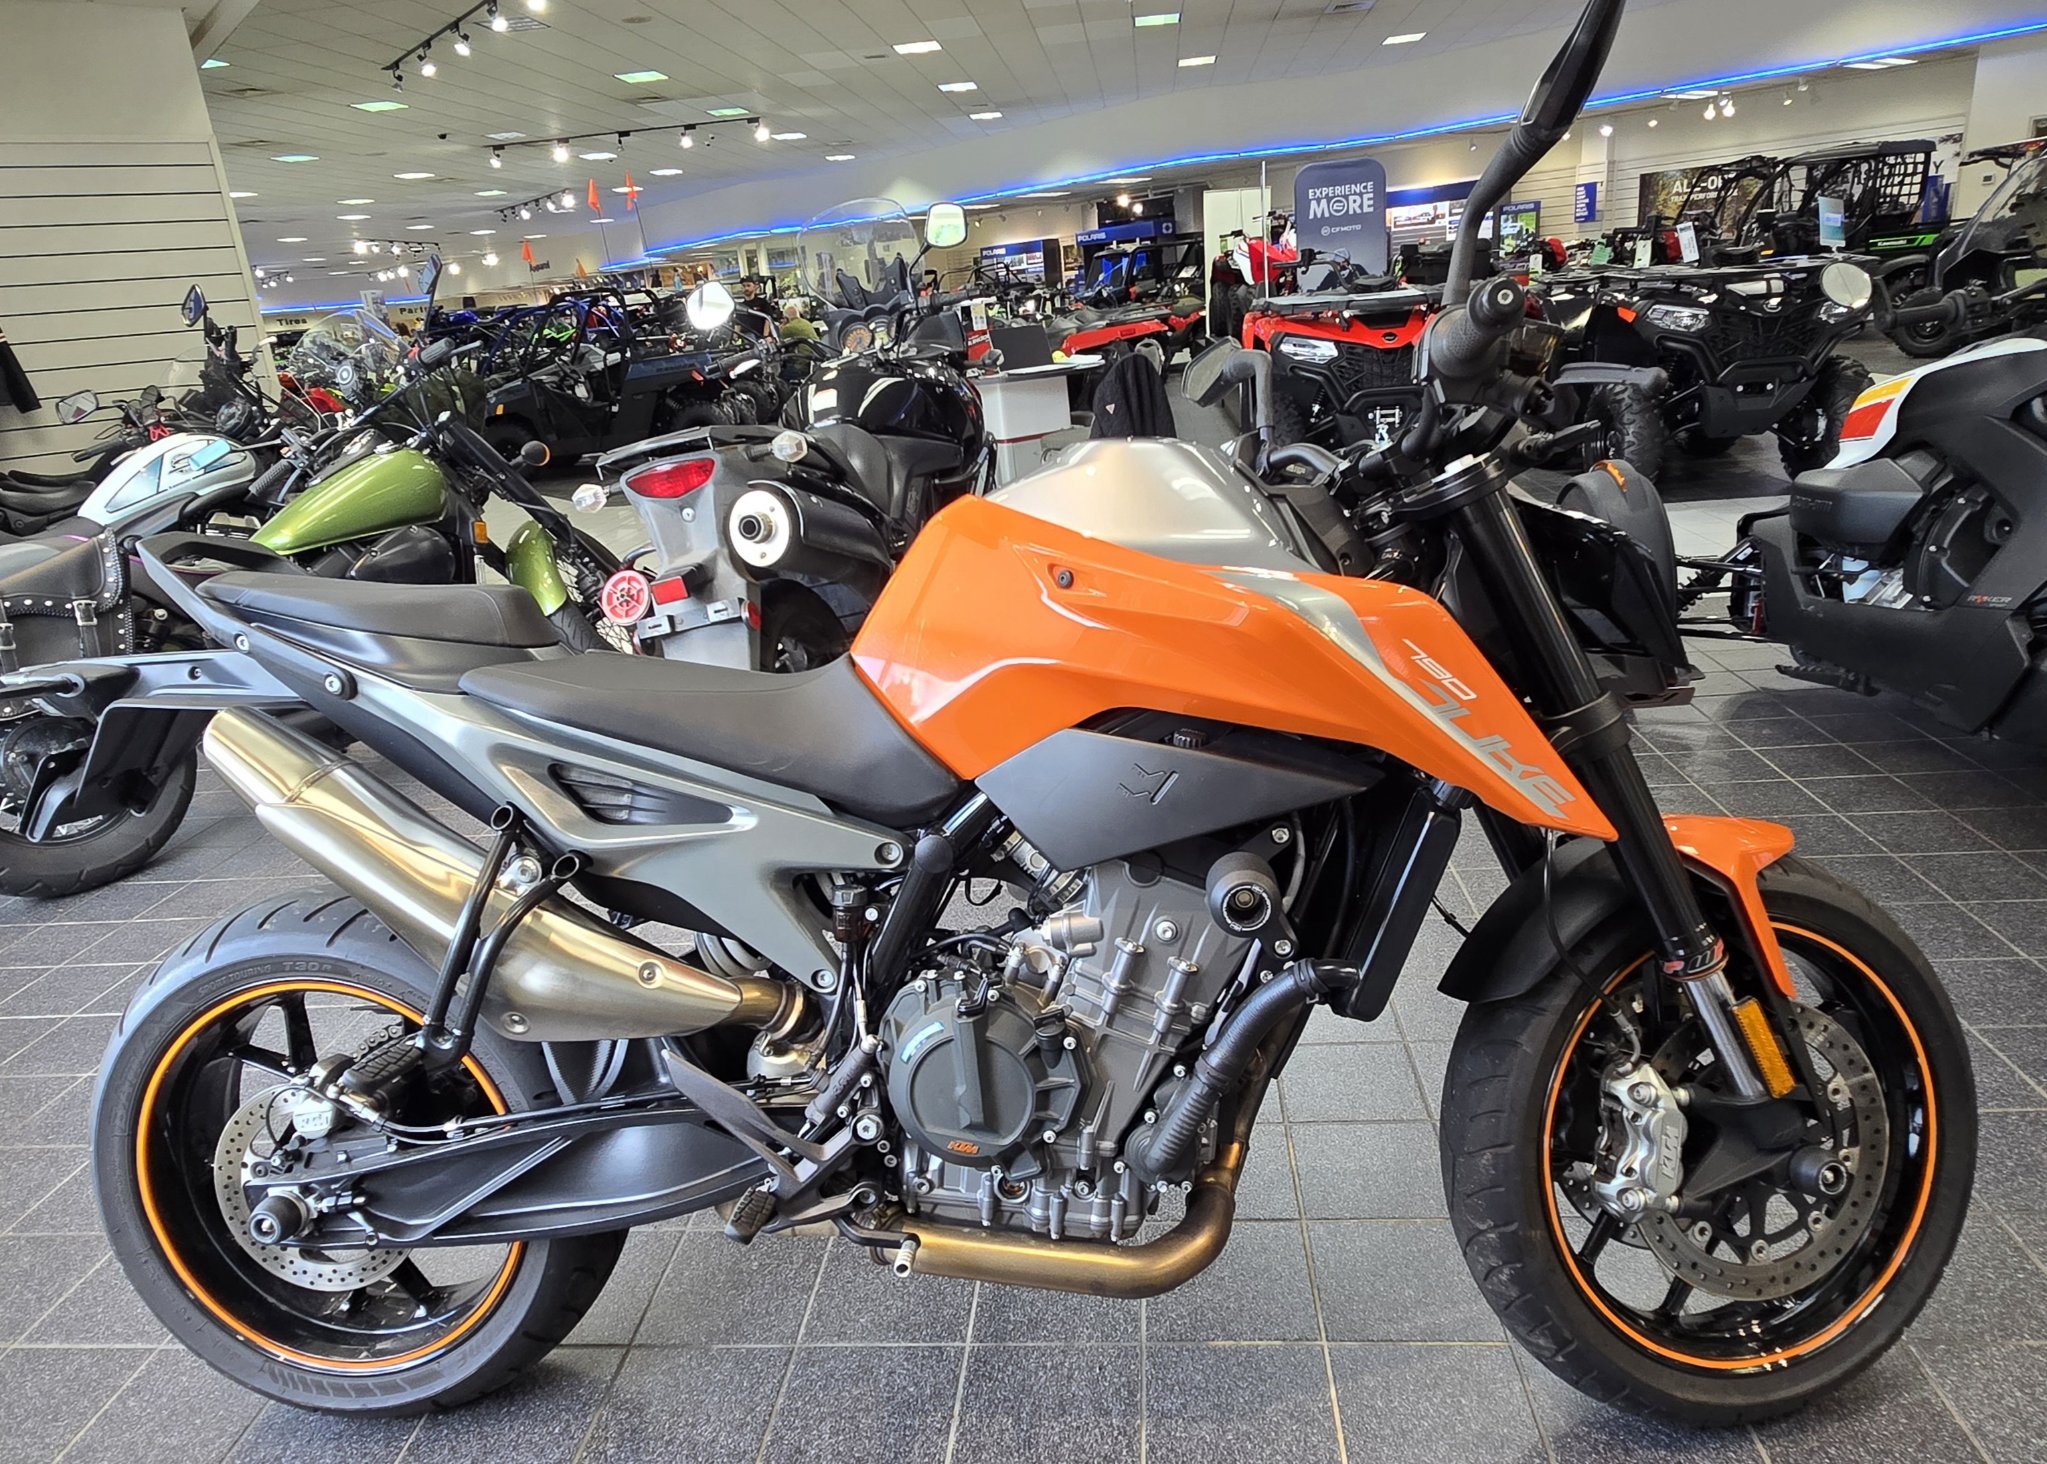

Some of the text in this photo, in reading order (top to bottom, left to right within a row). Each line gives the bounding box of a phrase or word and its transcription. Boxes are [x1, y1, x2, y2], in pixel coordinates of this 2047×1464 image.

[1308, 181, 1374, 200] EXPERIENCE
[1308, 193, 1374, 220] MORE
[1502, 202, 1535, 212] POLARIS
[1077, 232, 1106, 243] POLARIS
[276, 317, 308, 327] Tires
[1402, 638, 1478, 701] 790
[1418, 677, 1577, 821] DUKE
[198, 976, 227, 998] SPORT
[228, 964, 272, 983] TOURING
[946, 1140, 980, 1155] KTM
[1660, 1124, 1680, 1181] KTM
